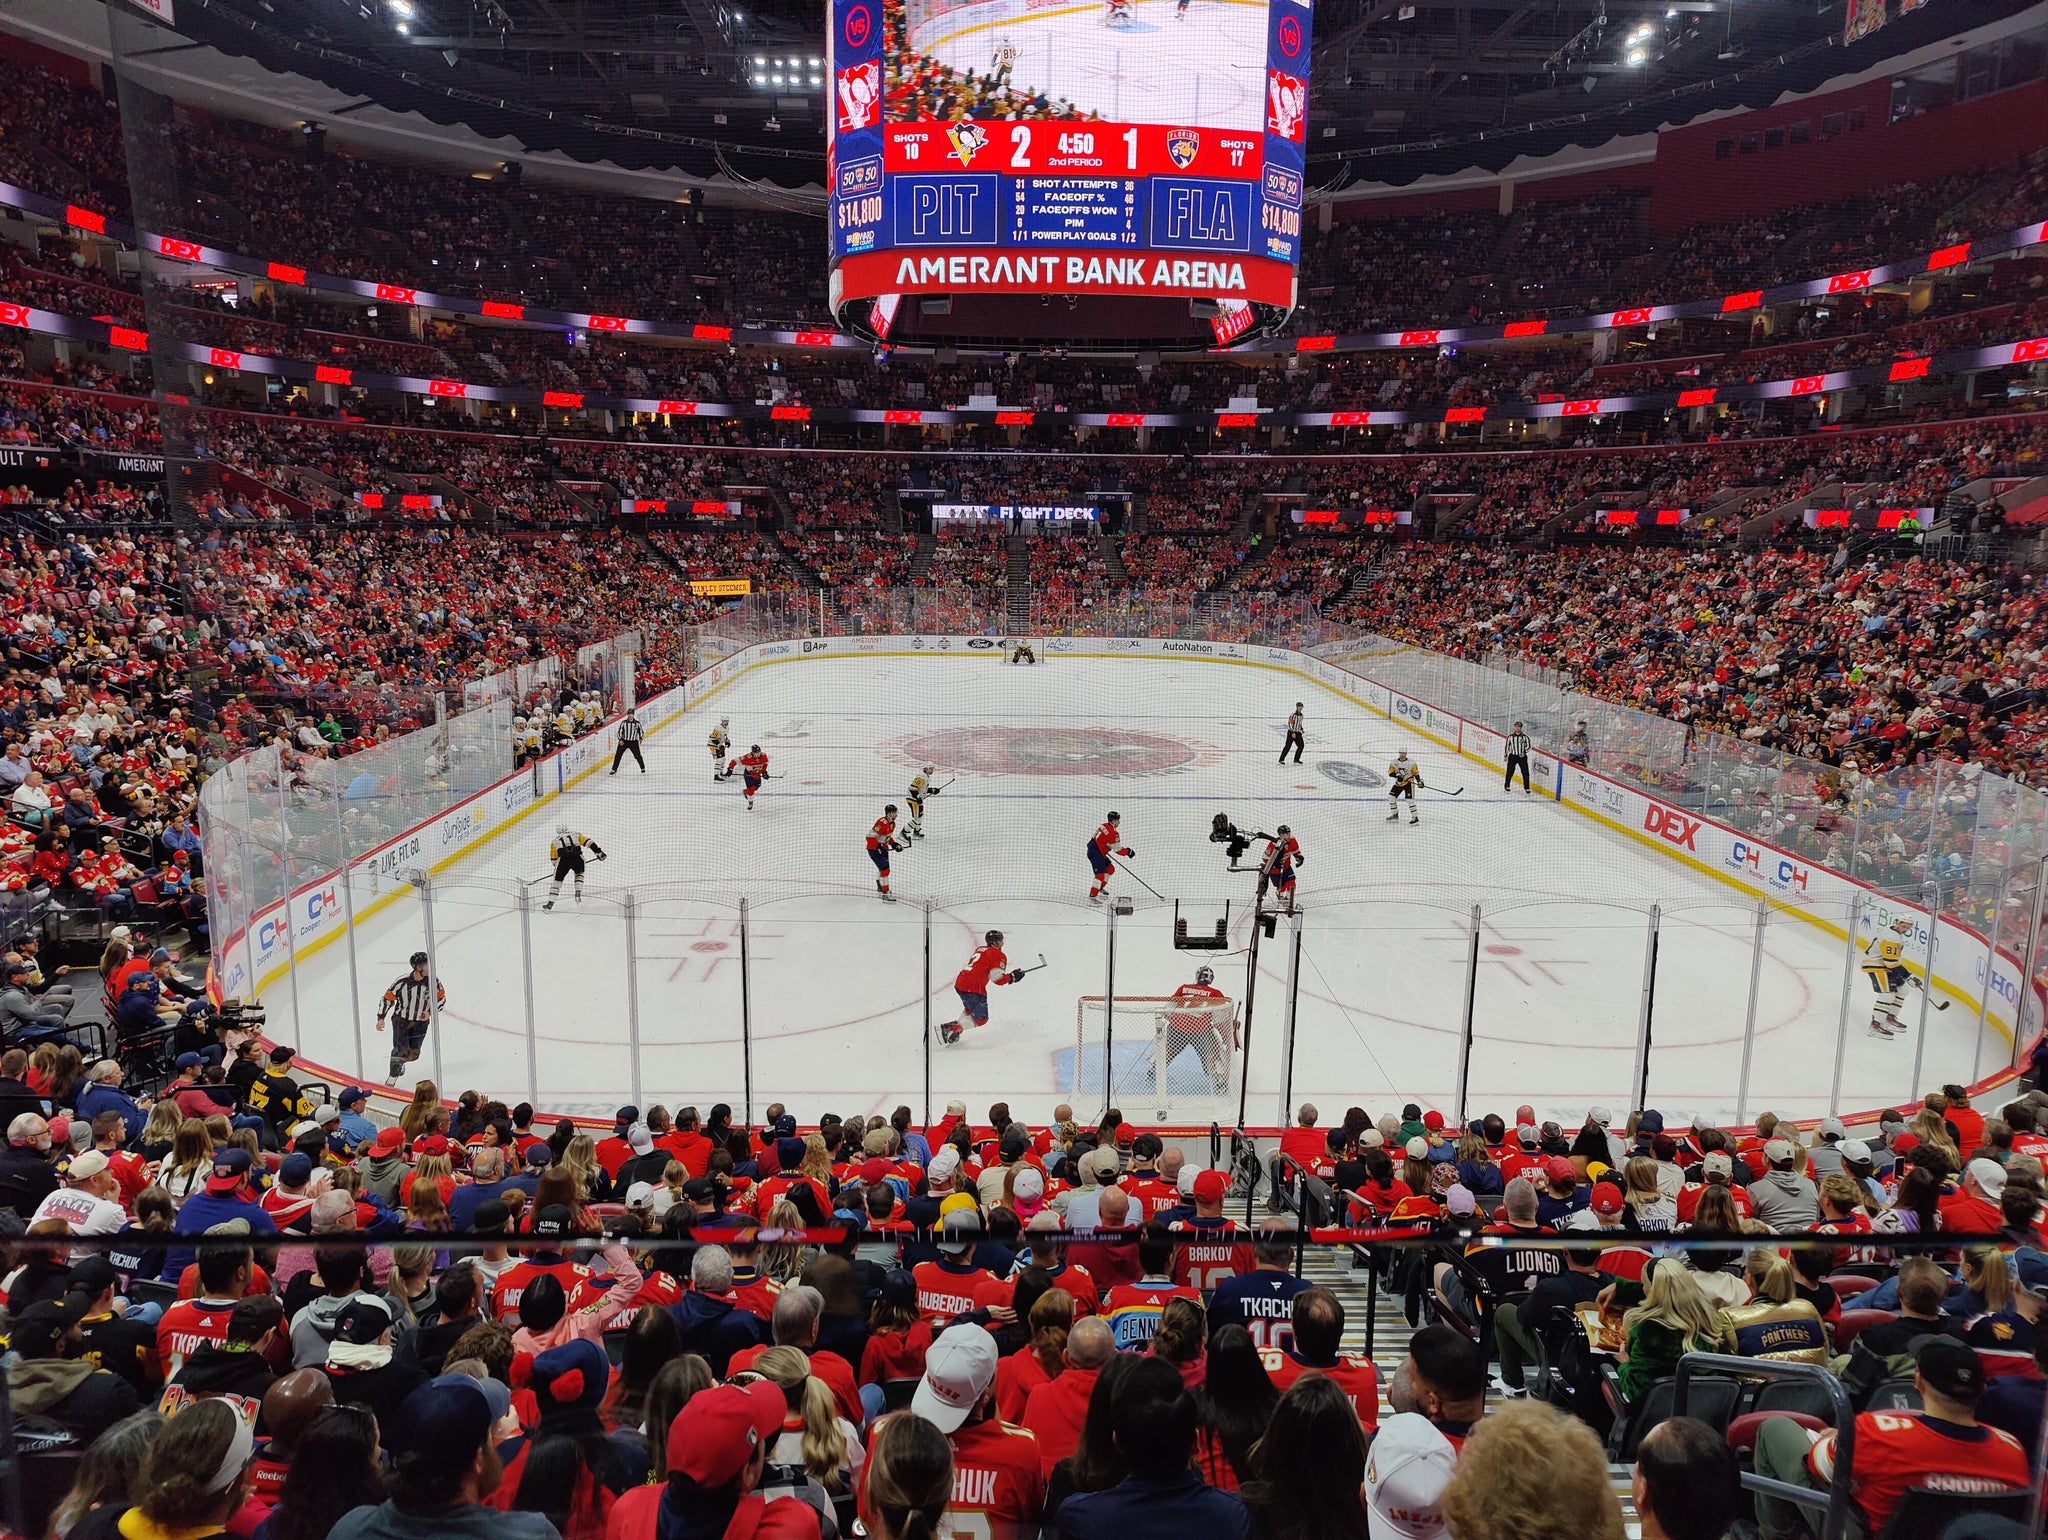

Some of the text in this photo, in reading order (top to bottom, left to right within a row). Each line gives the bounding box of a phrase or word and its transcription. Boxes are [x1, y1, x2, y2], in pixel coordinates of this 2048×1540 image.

[850, 17, 866, 36] VS
[1283, 27, 1297, 47] VS
[1003, 49, 1013, 59] 81
[894, 134, 928, 142] SHOTS
[1011, 125, 1031, 168] 2
[1058, 133, 1094, 154] 4:50
[1220, 140, 1254, 150] SHOTS
[904, 143, 919, 160] 10
[1123, 128, 1138, 169] 1
[1048, 158, 1102, 167] 2nd PERIOD
[1230, 150, 1245, 167] 17
[842, 166, 877, 186] 50 50
[1015, 179, 1025, 189] 31
[1032, 180, 1060, 189] SHOT
[1062, 180, 1118, 190] ATTEMPTS
[1267, 175, 1297, 195] 50 50
[1015, 192, 1025, 202] 54
[1045, 193, 1094, 202] FACEOFF
[1096, 194, 1105, 202] %
[838, 196, 882, 229] $14,800
[913, 184, 979, 235] PIT
[1015, 205, 1134, 217] 20 FACEOFFS WON 17
[1168, 188, 1235, 241] FLA
[66, 205, 105, 234] DEX
[1065, 219, 1084, 228] PIM
[1125, 220, 1132, 230] 4
[1262, 203, 1299, 237] $14,800
[1013, 231, 1136, 243] 1/1 POWER PLAY GOALS 1/2
[160, 237, 202, 262] DEX
[1928, 243, 1971, 271] DEX
[268, 262, 306, 285] DEX
[896, 256, 1246, 290] AMERANT BANK ARENA
[1828, 270, 1873, 294] DEX
[376, 283, 417, 304] DEX
[1722, 290, 1763, 312] DEX
[0, 303, 30, 328] EX
[481, 301, 525, 319] DEX
[1611, 307, 1653, 327] DEX
[588, 315, 629, 331] DEX
[1503, 320, 1547, 338] DEX
[110, 326, 149, 352] DEX
[692, 324, 732, 341] DEX
[795, 332, 834, 346] DEX
[1400, 330, 1441, 345] DEX
[1296, 336, 1337, 351] DEX
[2012, 337, 2048, 362] DE
[210, 348, 241, 369] DEX
[1889, 353, 1931, 381] DEX
[315, 365, 352, 385] DEX
[429, 378, 467, 397] DEX
[1790, 374, 1826, 395] DEX
[543, 391, 584, 408] DEX
[1677, 388, 1717, 407] DEX
[658, 400, 699, 414] DEX
[771, 406, 811, 420] DEX
[1445, 406, 1487, 422] DEX
[1561, 399, 1601, 416] DEX
[884, 410, 923, 423] DEX
[995, 412, 1035, 425] DEX
[1106, 414, 1146, 426] DEX
[1218, 414, 1258, 427] DEX
[1331, 411, 1371, 425] DEX
[118, 458, 165, 473] AMERANT
[1054, 507, 1095, 520] DECK
[1303, 511, 1340, 523] DEX
[692, 583, 747, 594] TANLEY STEEMER
[971, 640, 990, 648] Ford
[1163, 642, 1212, 651] AutoNation
[1644, 803, 1701, 852] DEX
[559, 835, 576, 848] 11
[1725, 857, 1742, 870] Cooper
[1733, 842, 1760, 869] CH
[1769, 877, 1788, 890] Cooper
[1778, 861, 1808, 890] CH
[308, 886, 336, 919] CH
[260, 917, 288, 950] CH
[300, 920, 320, 936] Cooper
[257, 951, 272, 967] Cooper
[1886, 947, 1897, 955] 81
[539, 1220, 561, 1229] FLORIDA
[1639, 1218, 1670, 1232] ARKOV
[109, 1250, 141, 1270] KACHUK
[1188, 1246, 1232, 1262] BARKOV
[1506, 1250, 1560, 1275] LUONGO
[918, 1291, 974, 1314] HUBERDE
[1240, 1297, 1293, 1318] TKACH
[1761, 1328, 1811, 1347] PANTHERS
[951, 1468, 998, 1505] HUK
